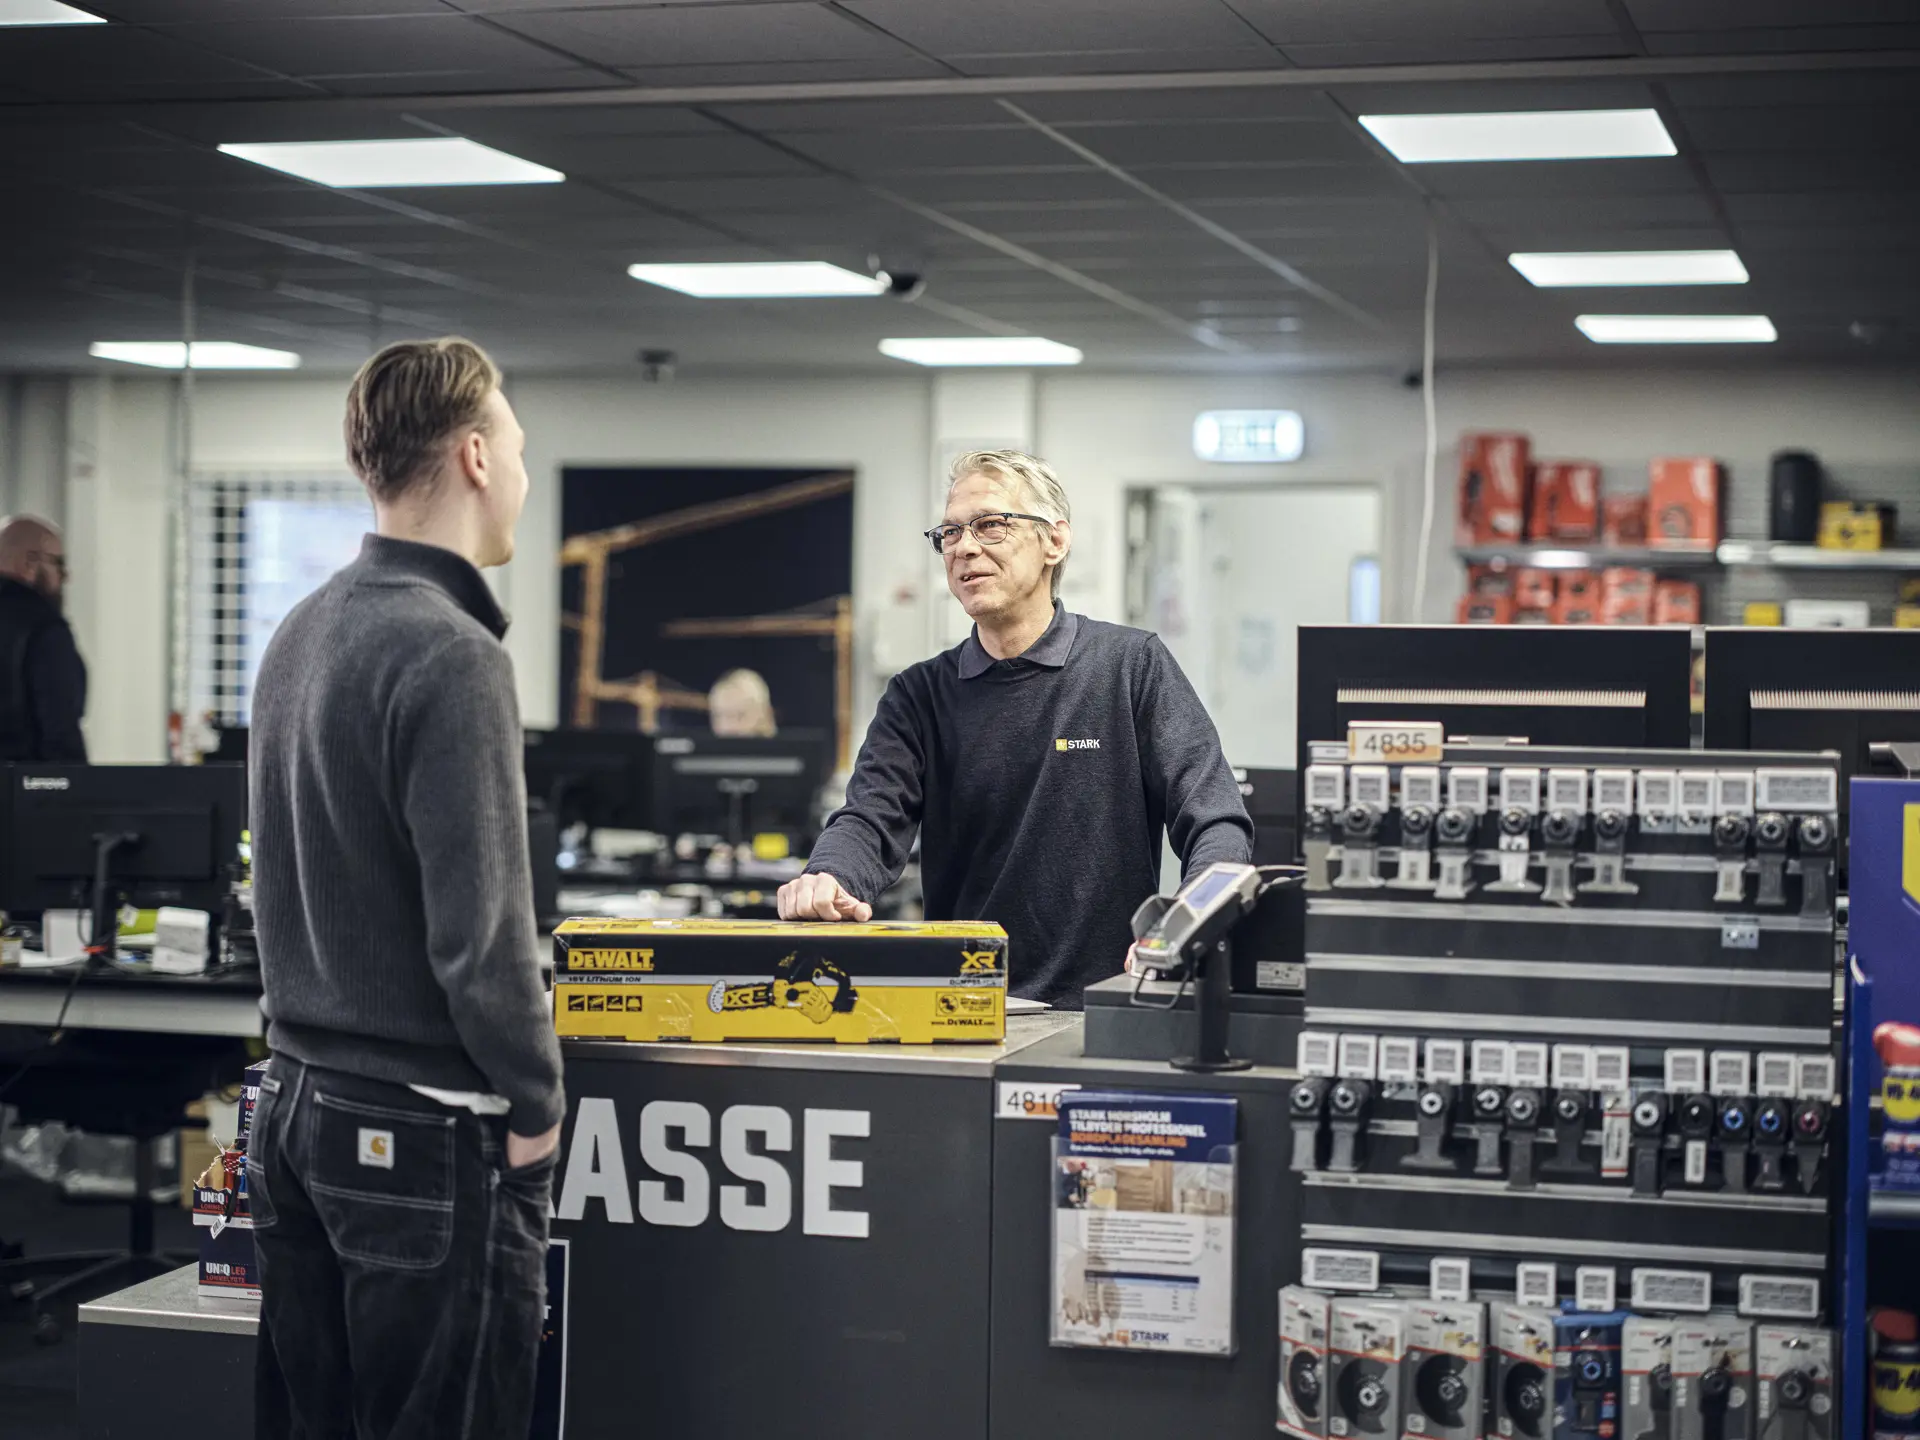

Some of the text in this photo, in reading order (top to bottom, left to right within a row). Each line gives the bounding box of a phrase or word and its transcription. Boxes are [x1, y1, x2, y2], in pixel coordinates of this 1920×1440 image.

[1067, 738, 1101, 749] STARK
[1364, 732, 1426, 754] 4835
[22, 776, 70, 790] Lenovo
[548, 1097, 870, 1238] ASSE
[231, 1266, 246, 1276] LED
[1131, 1329, 1169, 1341] STARK
